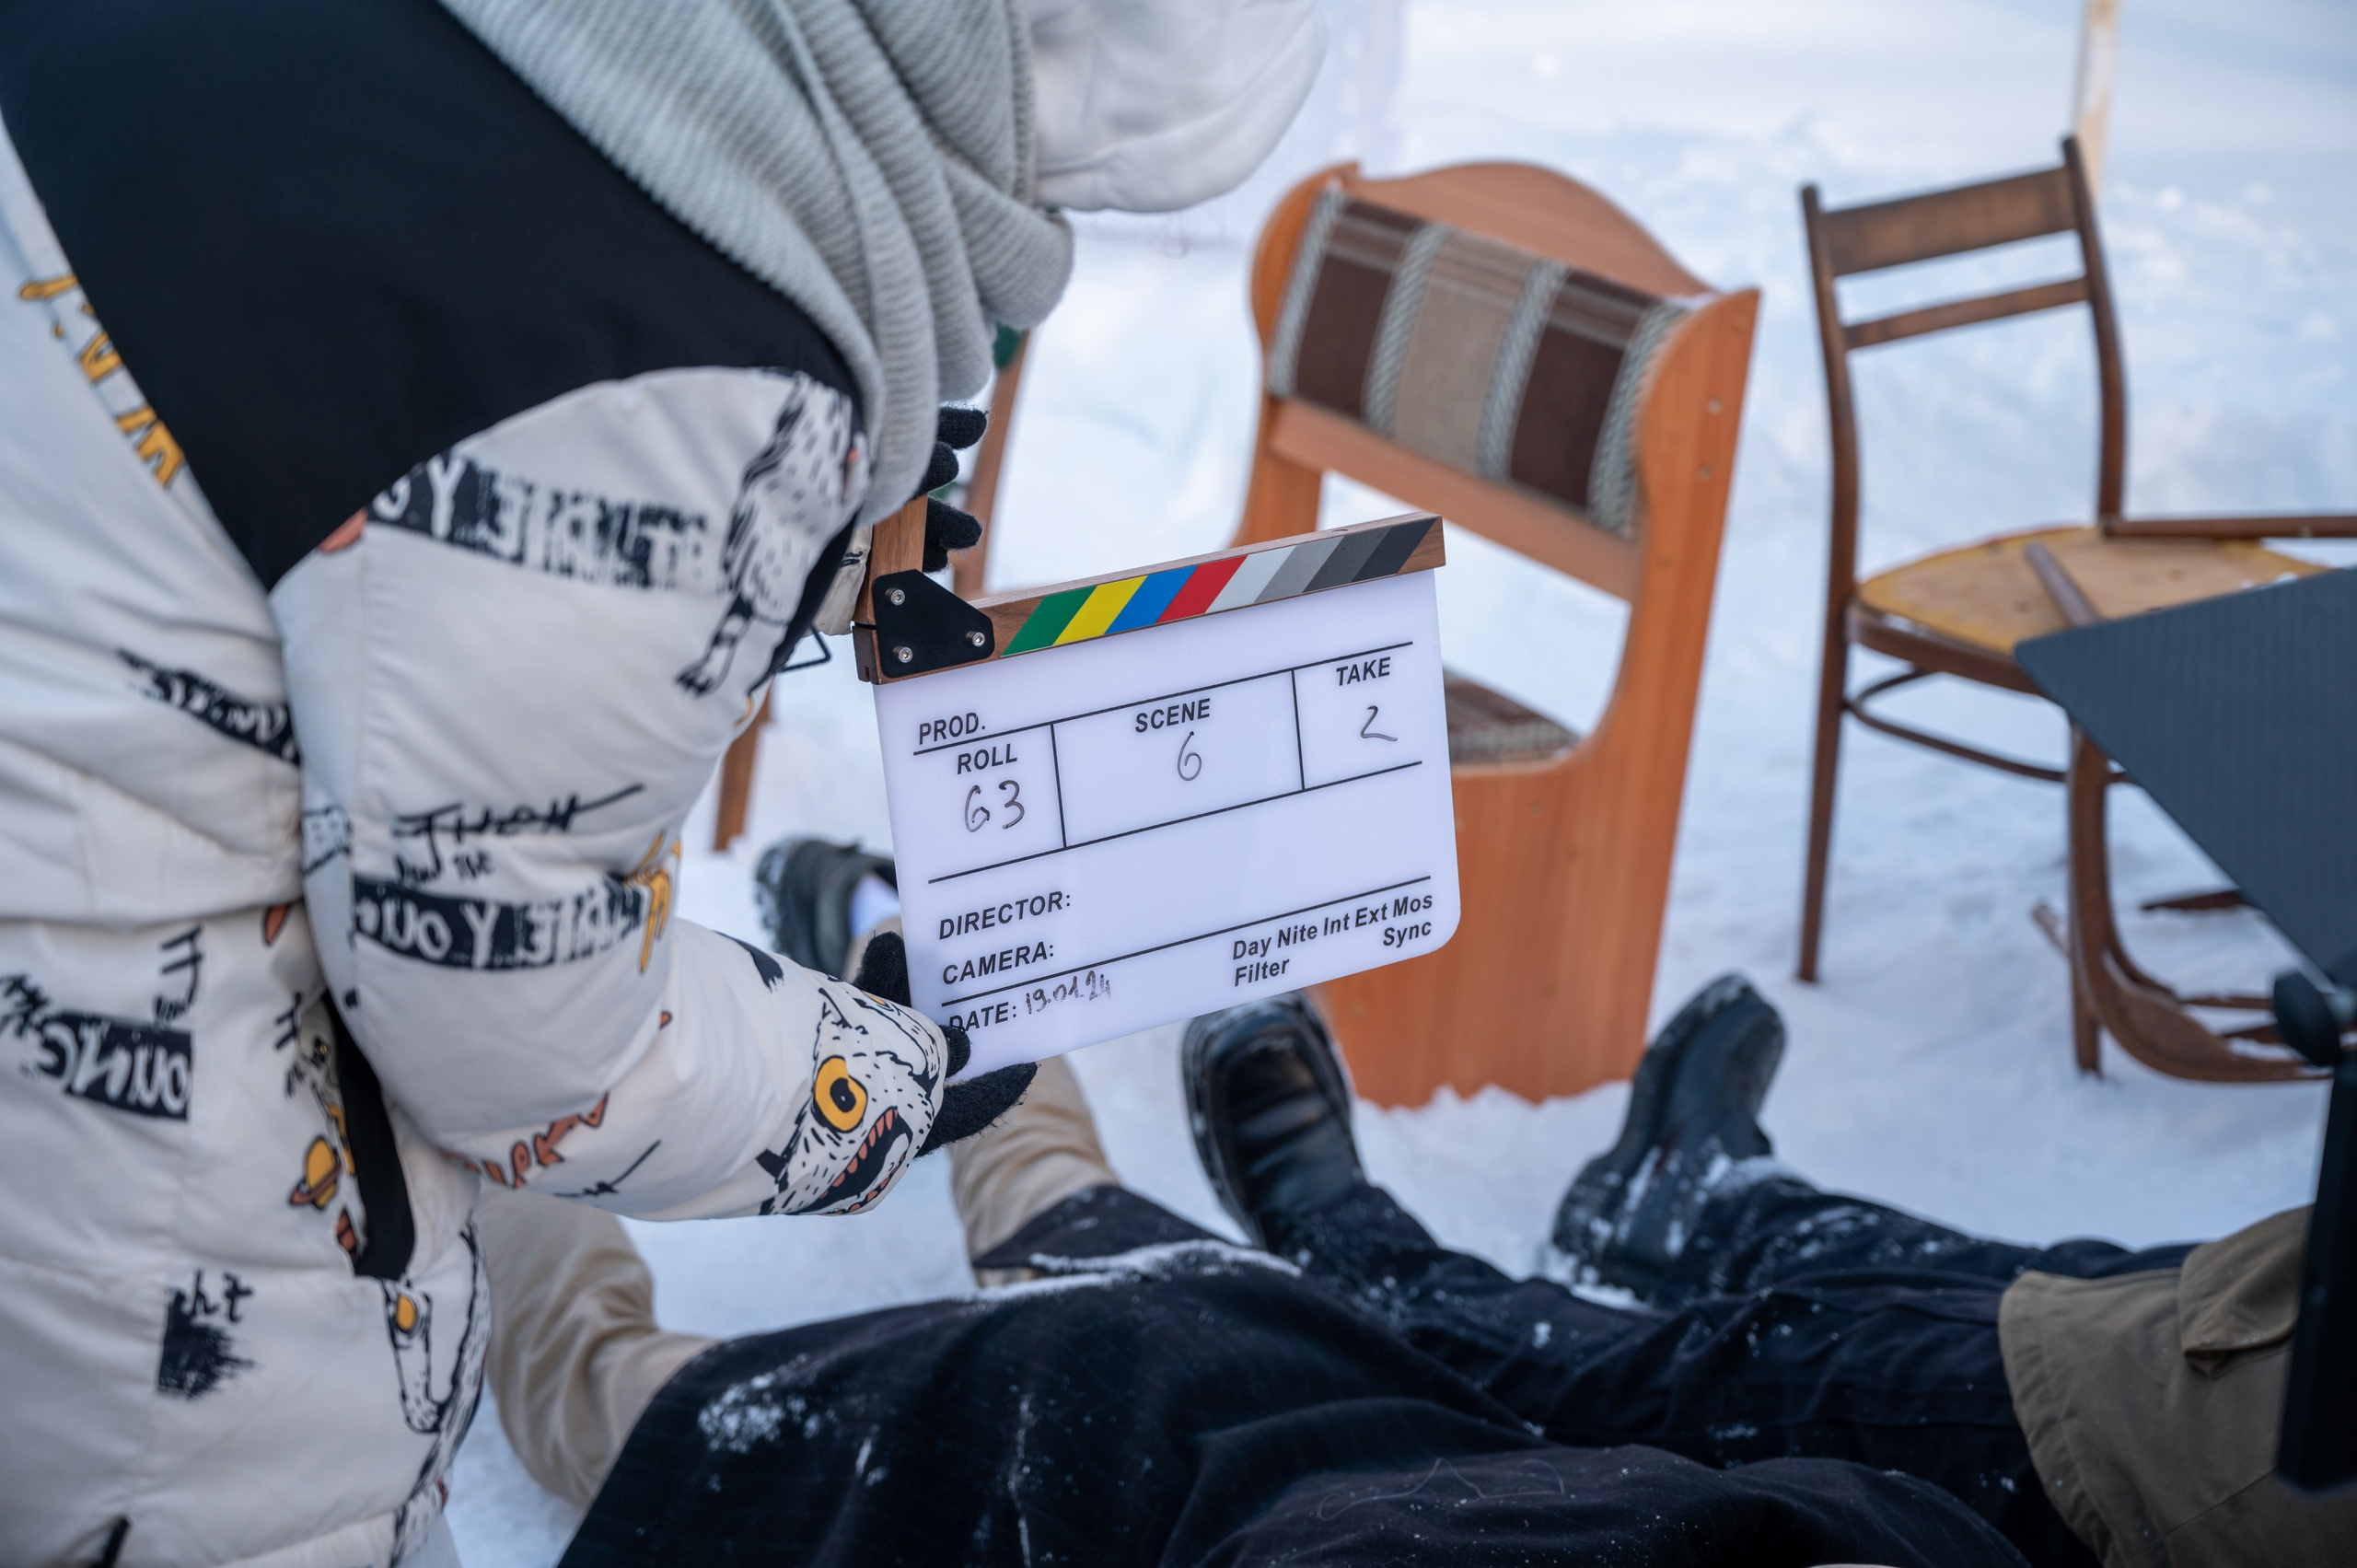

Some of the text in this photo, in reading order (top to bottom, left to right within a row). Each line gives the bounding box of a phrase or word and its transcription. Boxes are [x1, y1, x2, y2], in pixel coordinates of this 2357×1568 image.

[1336, 656, 1391, 687] TAKE
[919, 712, 986, 746] PROD.
[1134, 697, 1211, 734] SCENE
[1360, 704, 1399, 742] 2
[957, 742, 1018, 775] ROLL
[1177, 730, 1202, 782] 6
[964, 779, 1026, 833] 63
[939, 890, 1071, 940] DIRECTOR:
[1233, 894, 1434, 961] Day Nite Int Ext Mos
[1383, 921, 1434, 948] Sync
[942, 941, 1054, 986] CAMERA:
[1235, 958, 1291, 988] Filter
[948, 1001, 1017, 1032] DATE:
